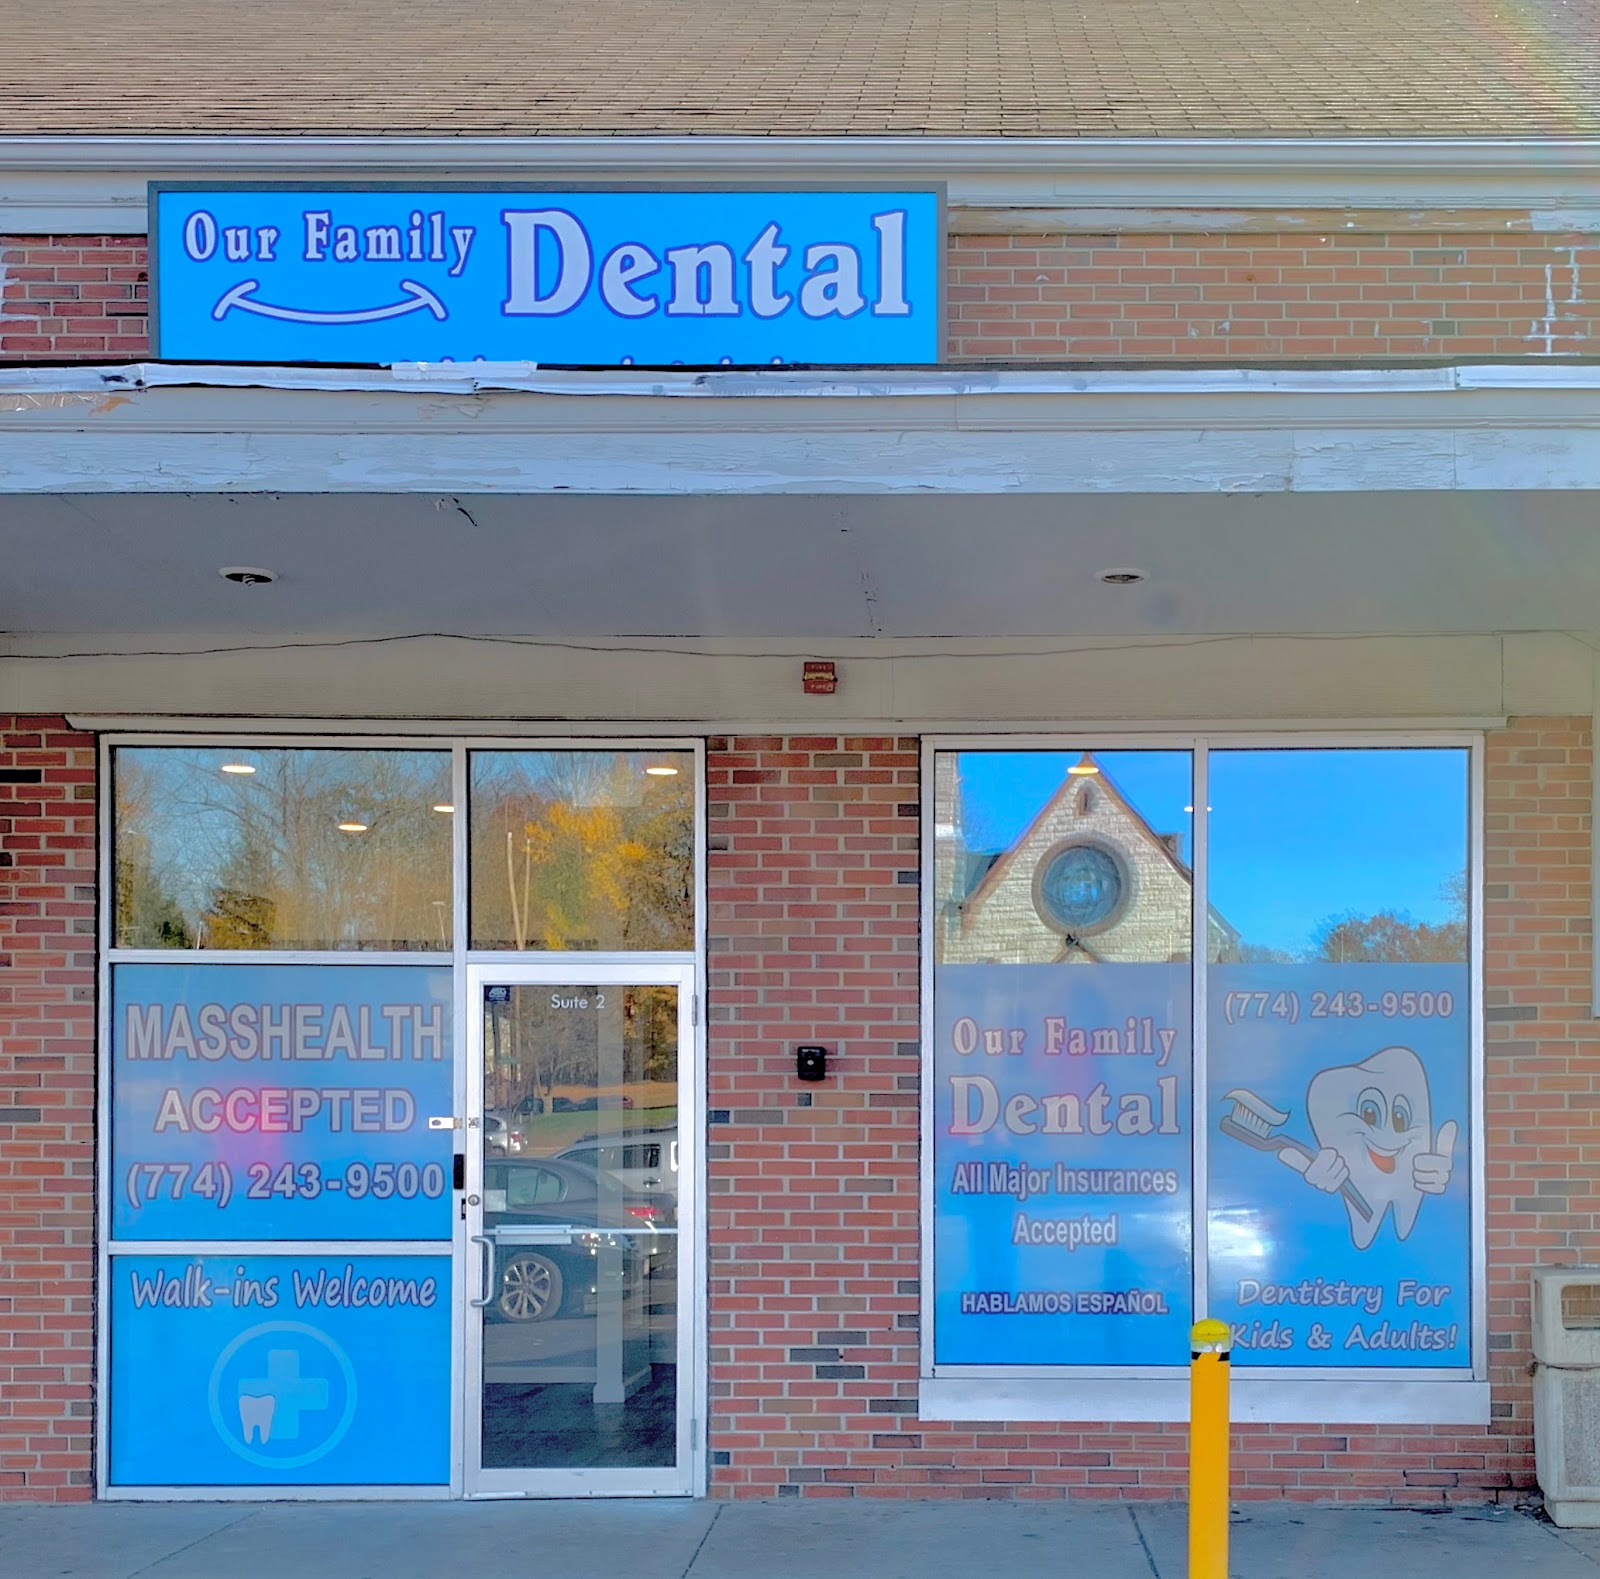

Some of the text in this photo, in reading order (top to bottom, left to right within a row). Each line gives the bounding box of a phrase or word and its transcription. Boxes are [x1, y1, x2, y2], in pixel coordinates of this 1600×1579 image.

[183, 208, 911, 320] Our Family Dental
[551, 994, 605, 1009] Suite 2
[1224, 990, 1453, 1024] (774) 243-9500
[125, 1003, 445, 1062] MASSHEALTH
[952, 1016, 1178, 1066] Our Family
[153, 1087, 417, 1133] ACCEPTED
[949, 1074, 1181, 1135] Dental
[126, 1161, 445, 1209] (774) 243-9500
[952, 1162, 1178, 1200] All Major Insurances
[1013, 1212, 1119, 1251] Accepted
[130, 1263, 437, 1309] Walk-ins Welcome
[961, 1290, 1168, 1314] HABLAMOS ESPAÑOL
[1236, 1277, 1452, 1314] Dentistry For
[1230, 1320, 1458, 1351] Kids & Adults!
